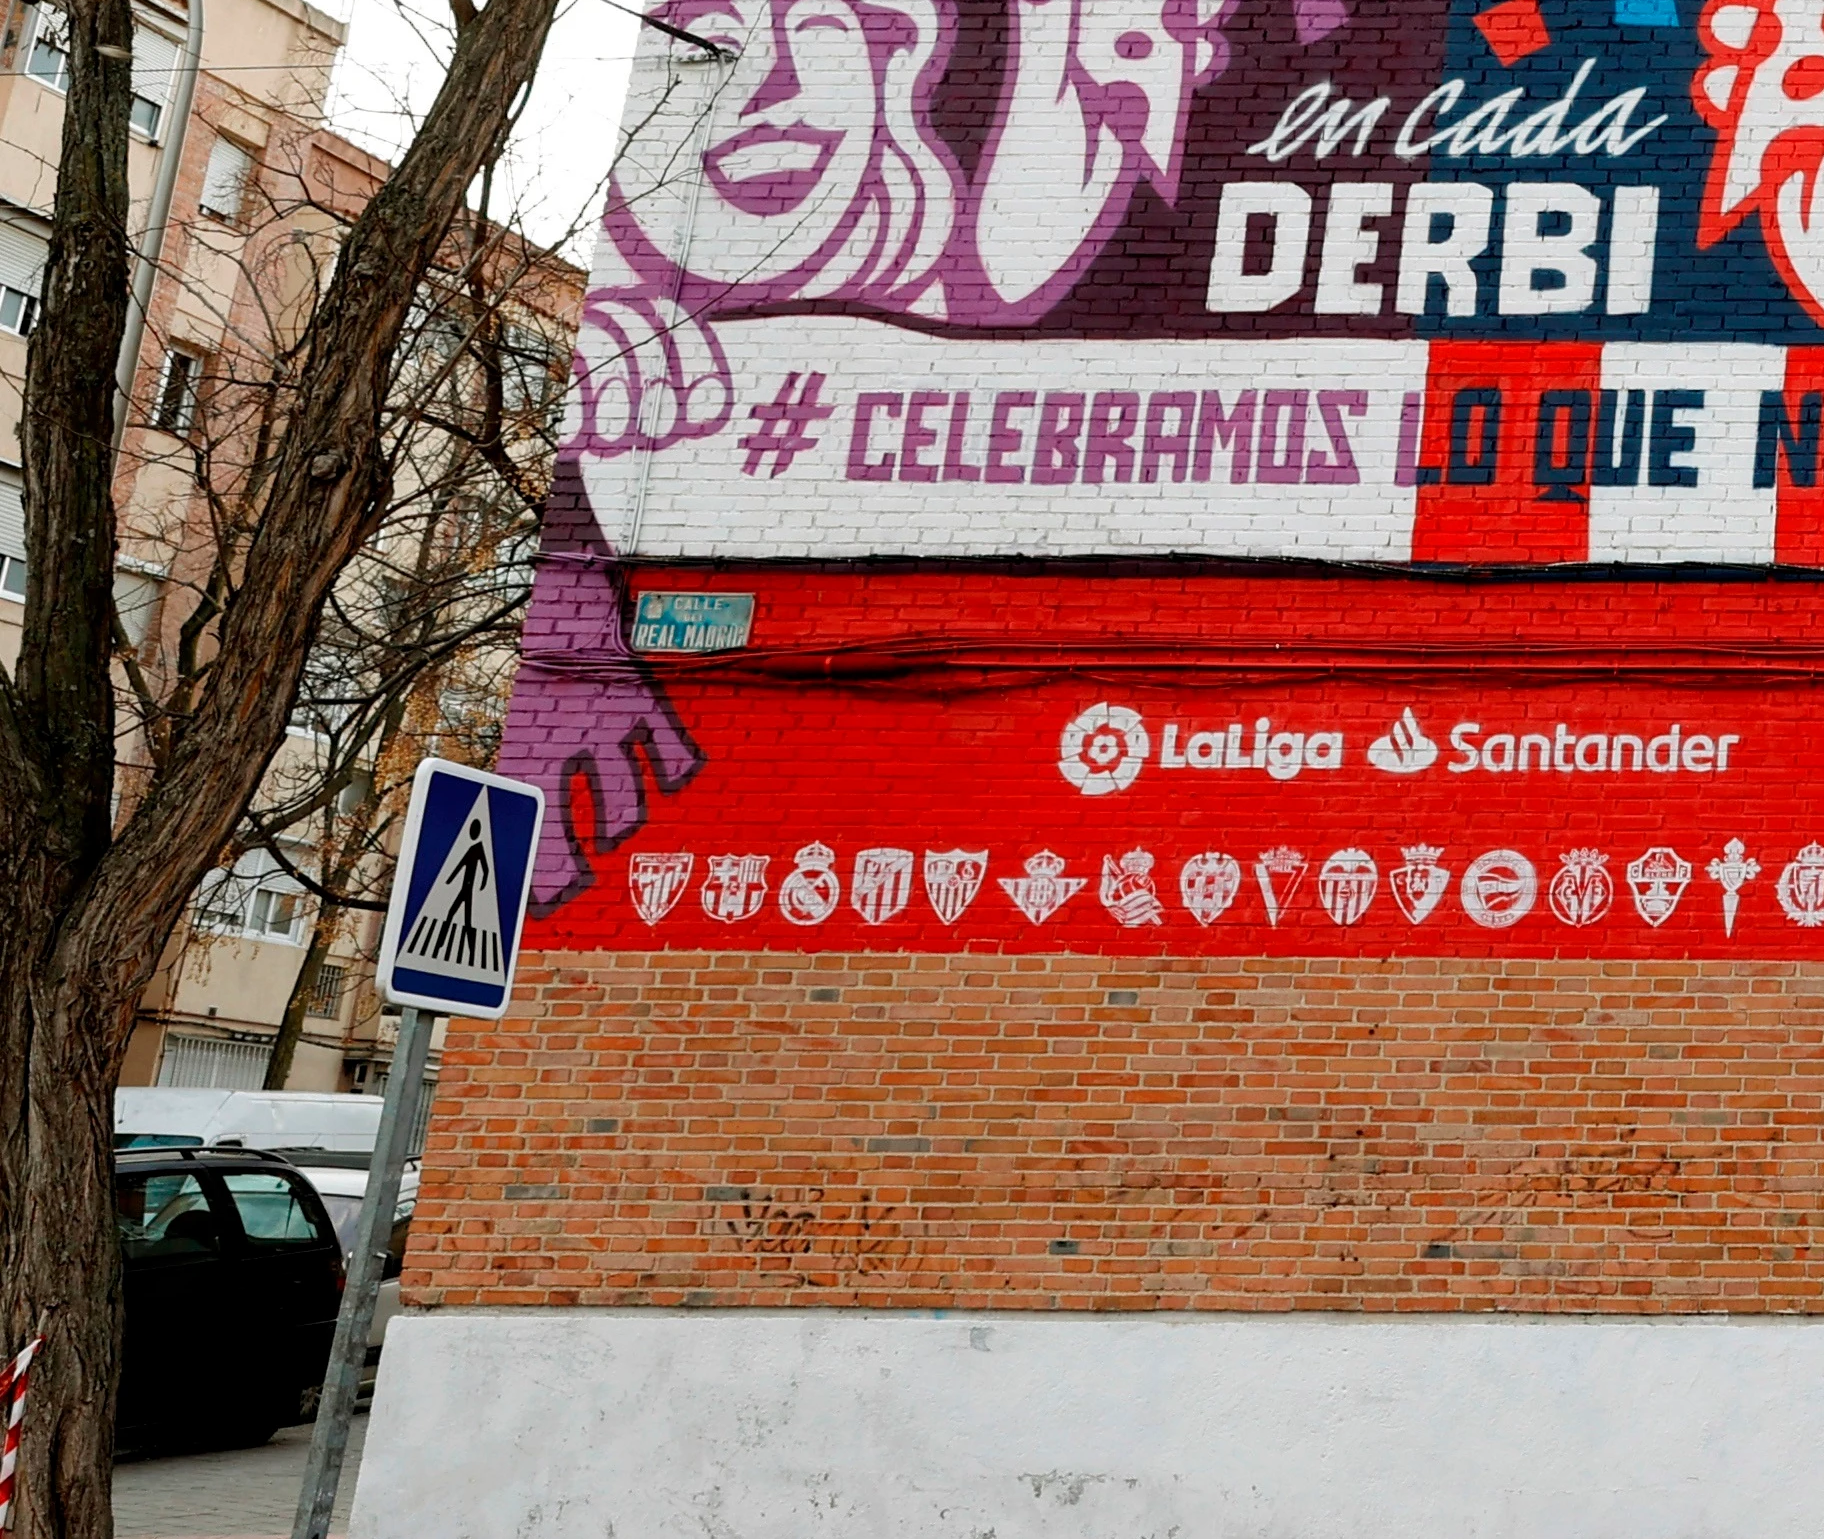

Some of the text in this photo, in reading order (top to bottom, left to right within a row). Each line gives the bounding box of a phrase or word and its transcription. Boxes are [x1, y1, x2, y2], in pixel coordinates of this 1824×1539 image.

[1245, 57, 1670, 163] en cada
[1206, 181, 1661, 316] DERBI
[1394, 387, 1498, 487] LO
[1531, 388, 1706, 502] QUE
[635, 623, 676, 648] REAL
[673, 597, 724, 611] CALLE
[1159, 717, 1343, 781] LaLiga
[1447, 721, 1741, 774] Santander
